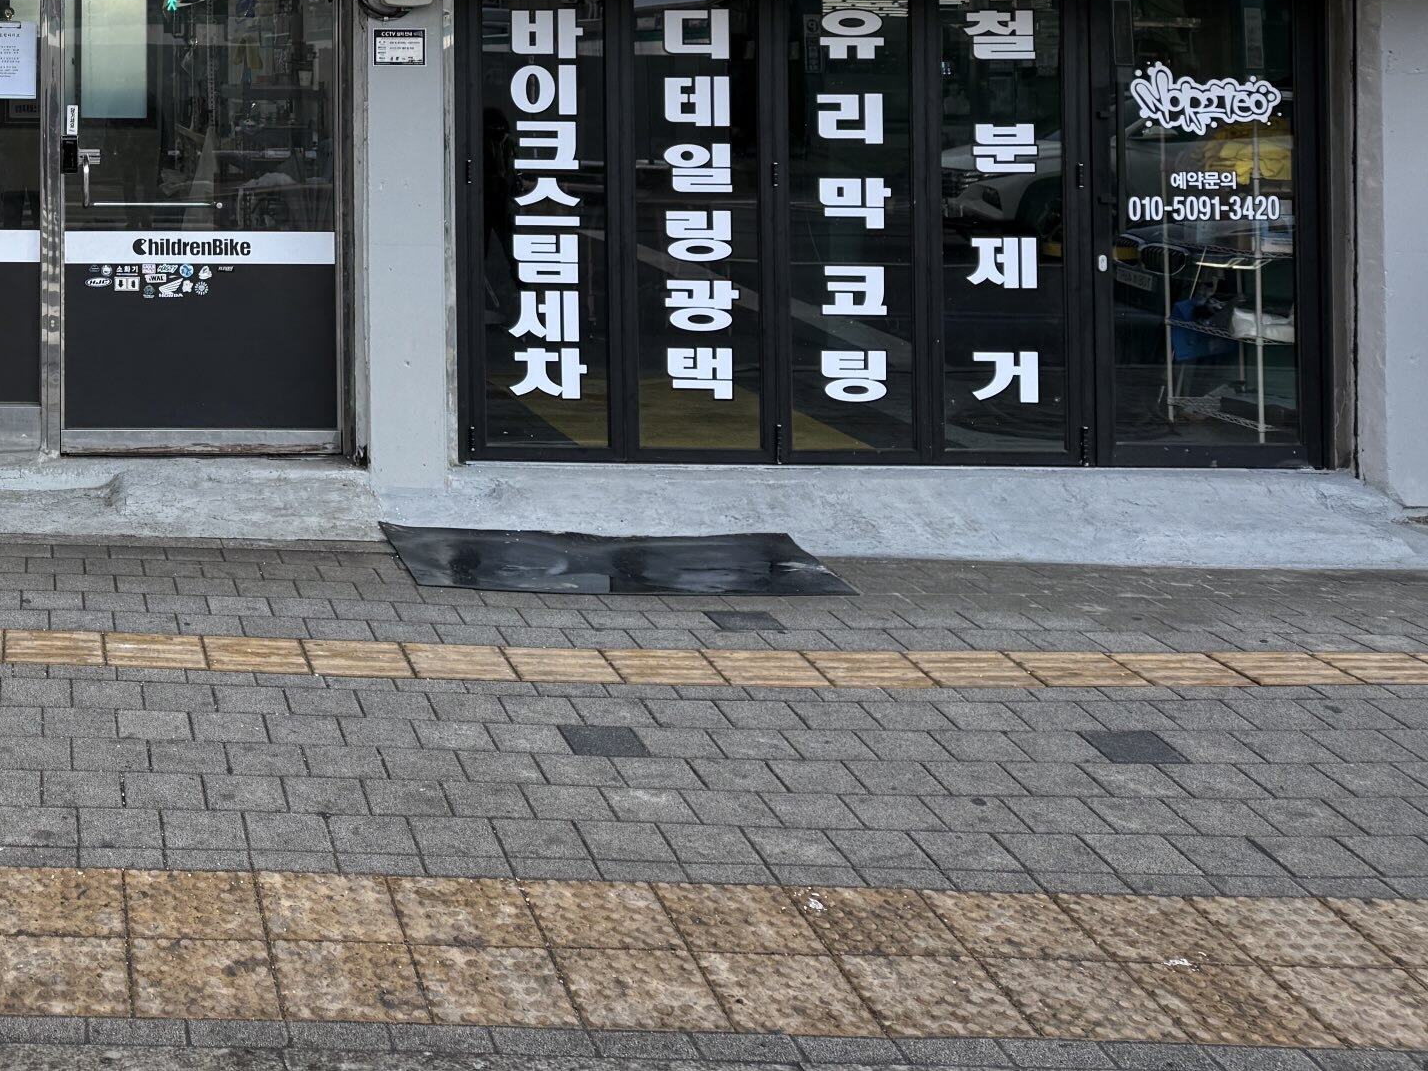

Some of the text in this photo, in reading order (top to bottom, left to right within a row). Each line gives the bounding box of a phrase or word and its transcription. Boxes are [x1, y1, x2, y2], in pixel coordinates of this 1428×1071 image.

[1171, 172, 1237, 190] 예약문의
[663, 8, 740, 401] 디테일링광택
[817, 8, 892, 403] 유리막코팅
[1128, 196, 1280, 221] 010-5091-3420
[132, 237, 252, 257] ChildrenBike
[115, 265, 139, 273] 소화기
